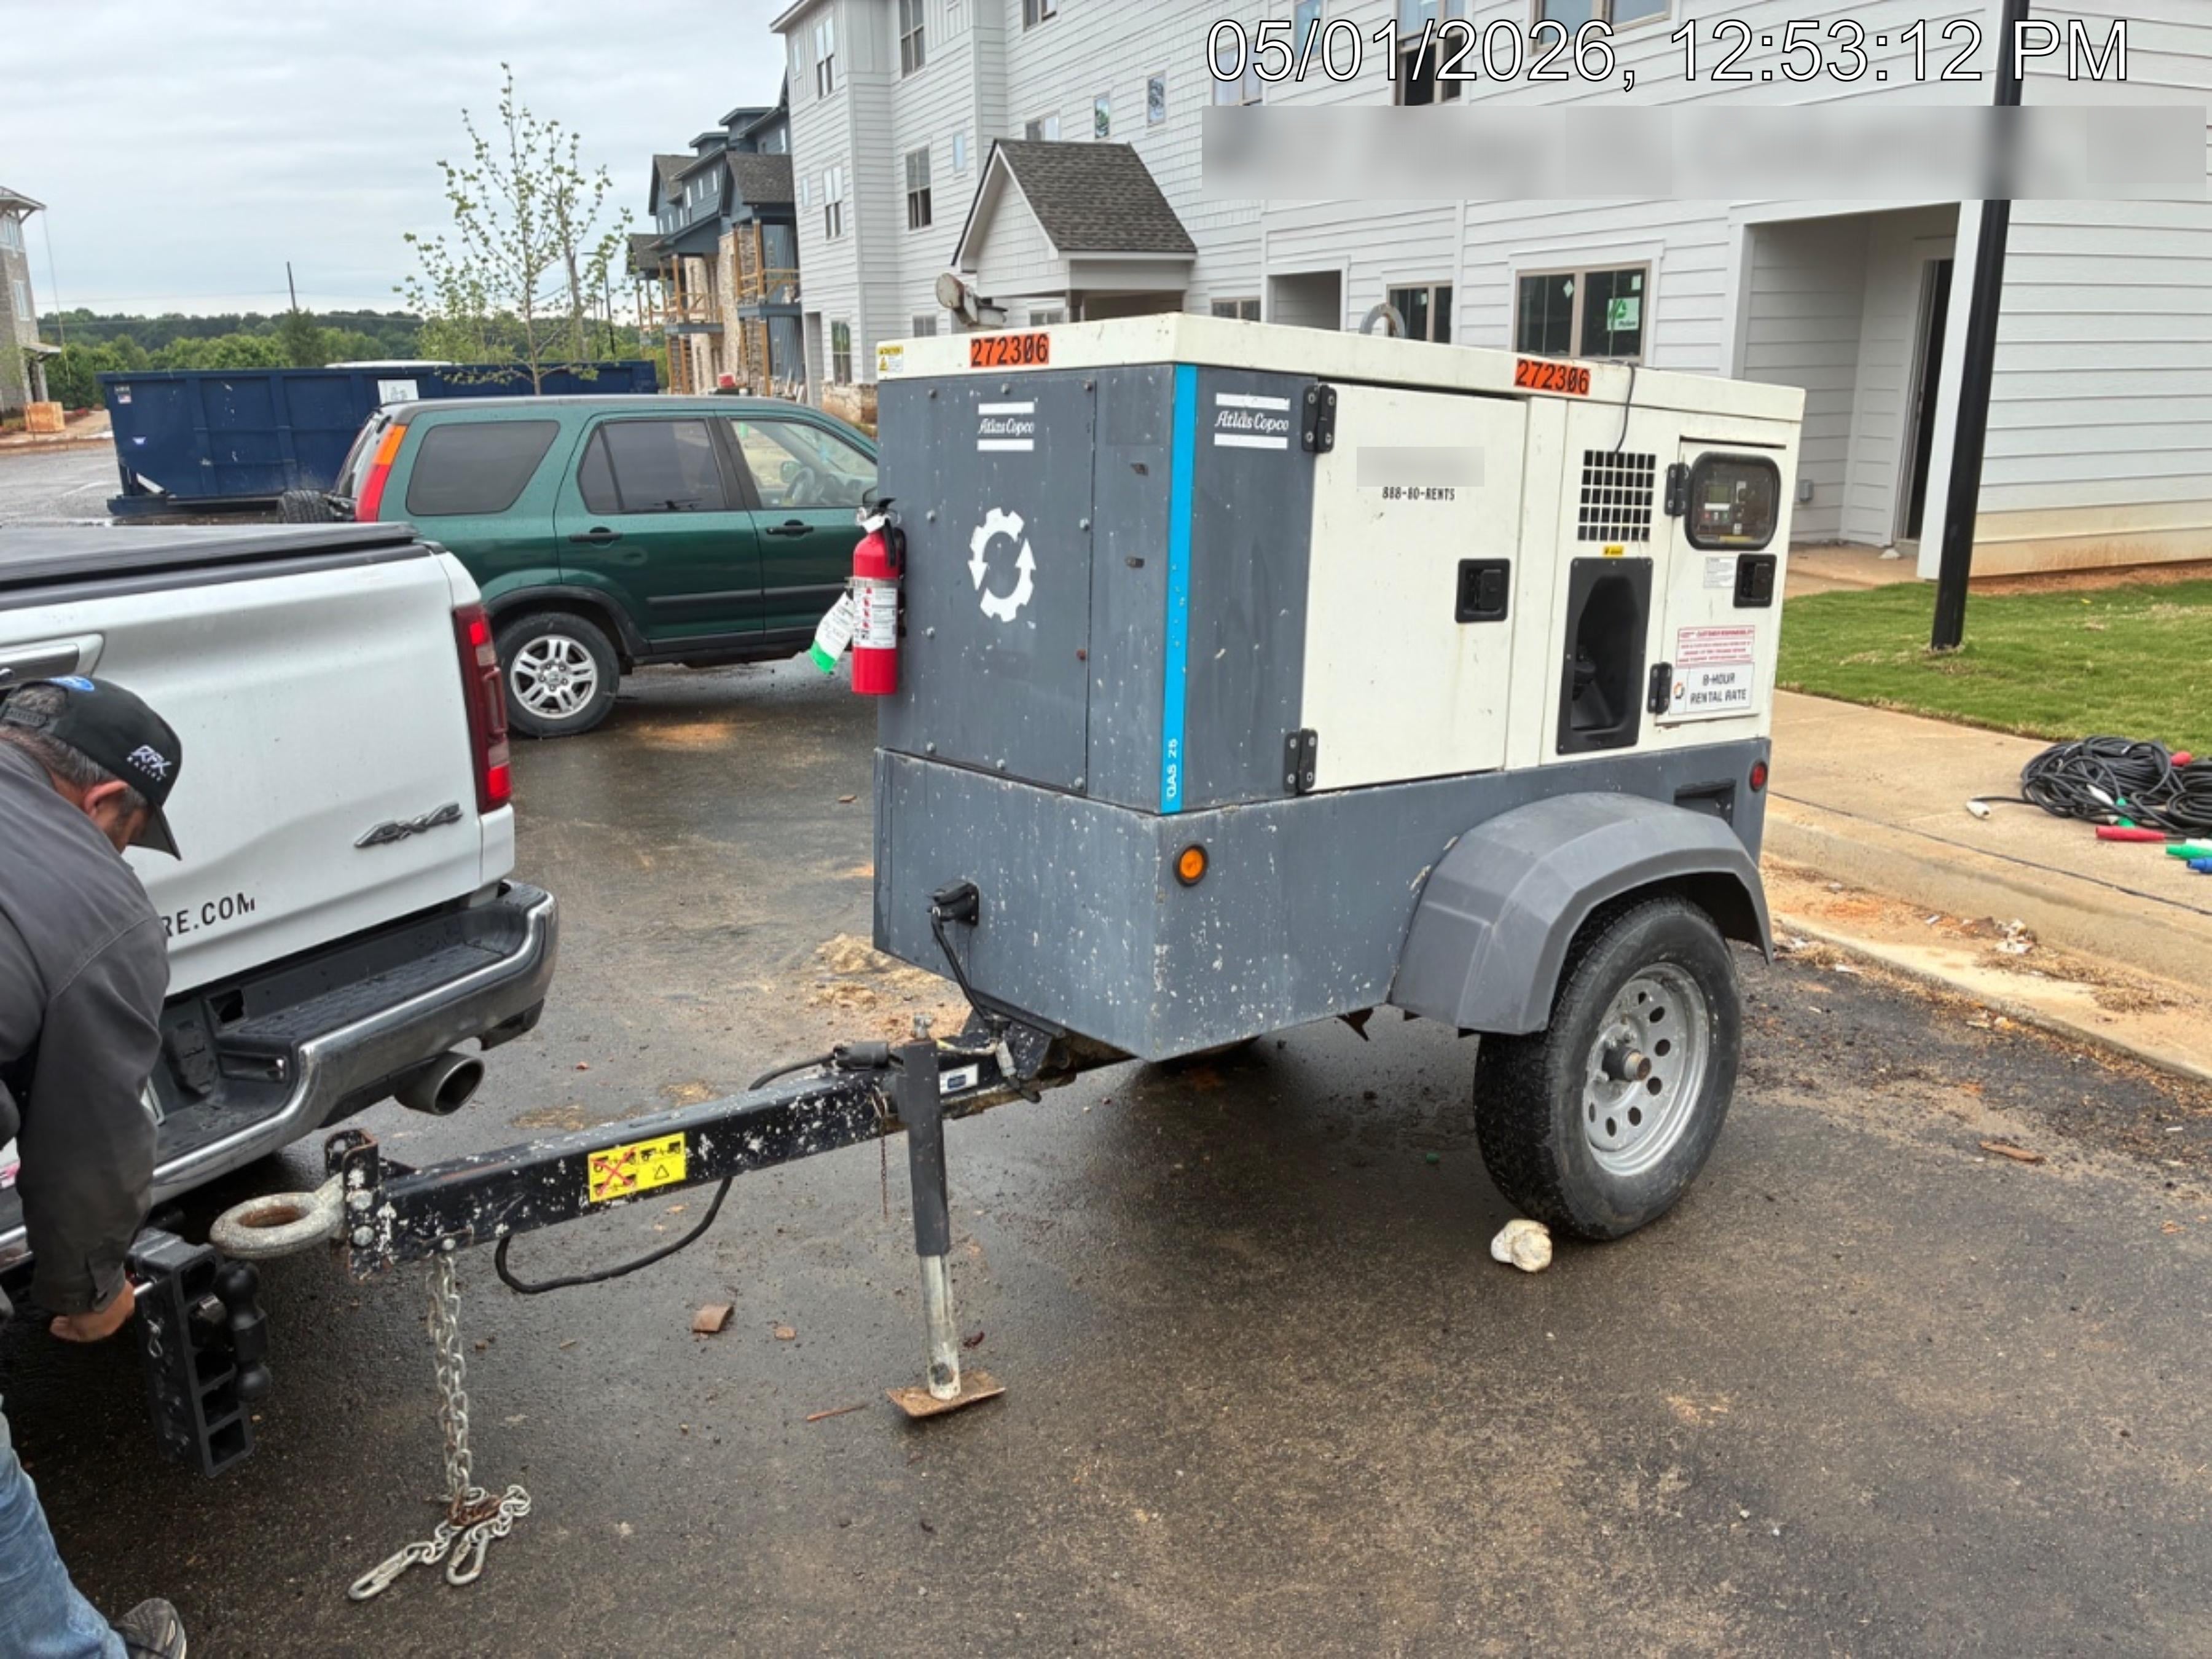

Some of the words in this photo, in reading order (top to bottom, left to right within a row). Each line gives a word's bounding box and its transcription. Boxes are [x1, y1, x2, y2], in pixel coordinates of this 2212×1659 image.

[971, 333, 1048, 367] 272306
[1515, 358, 1590, 394] 272306
[978, 418, 1005, 434] Atlas
[1006, 418, 1034, 436] Copco
[1214, 410, 1252, 429] Atlas
[1253, 412, 1289, 434] Copco
[1690, 691, 1722, 704] RENTAL
[1725, 689, 1747, 701] RATE
